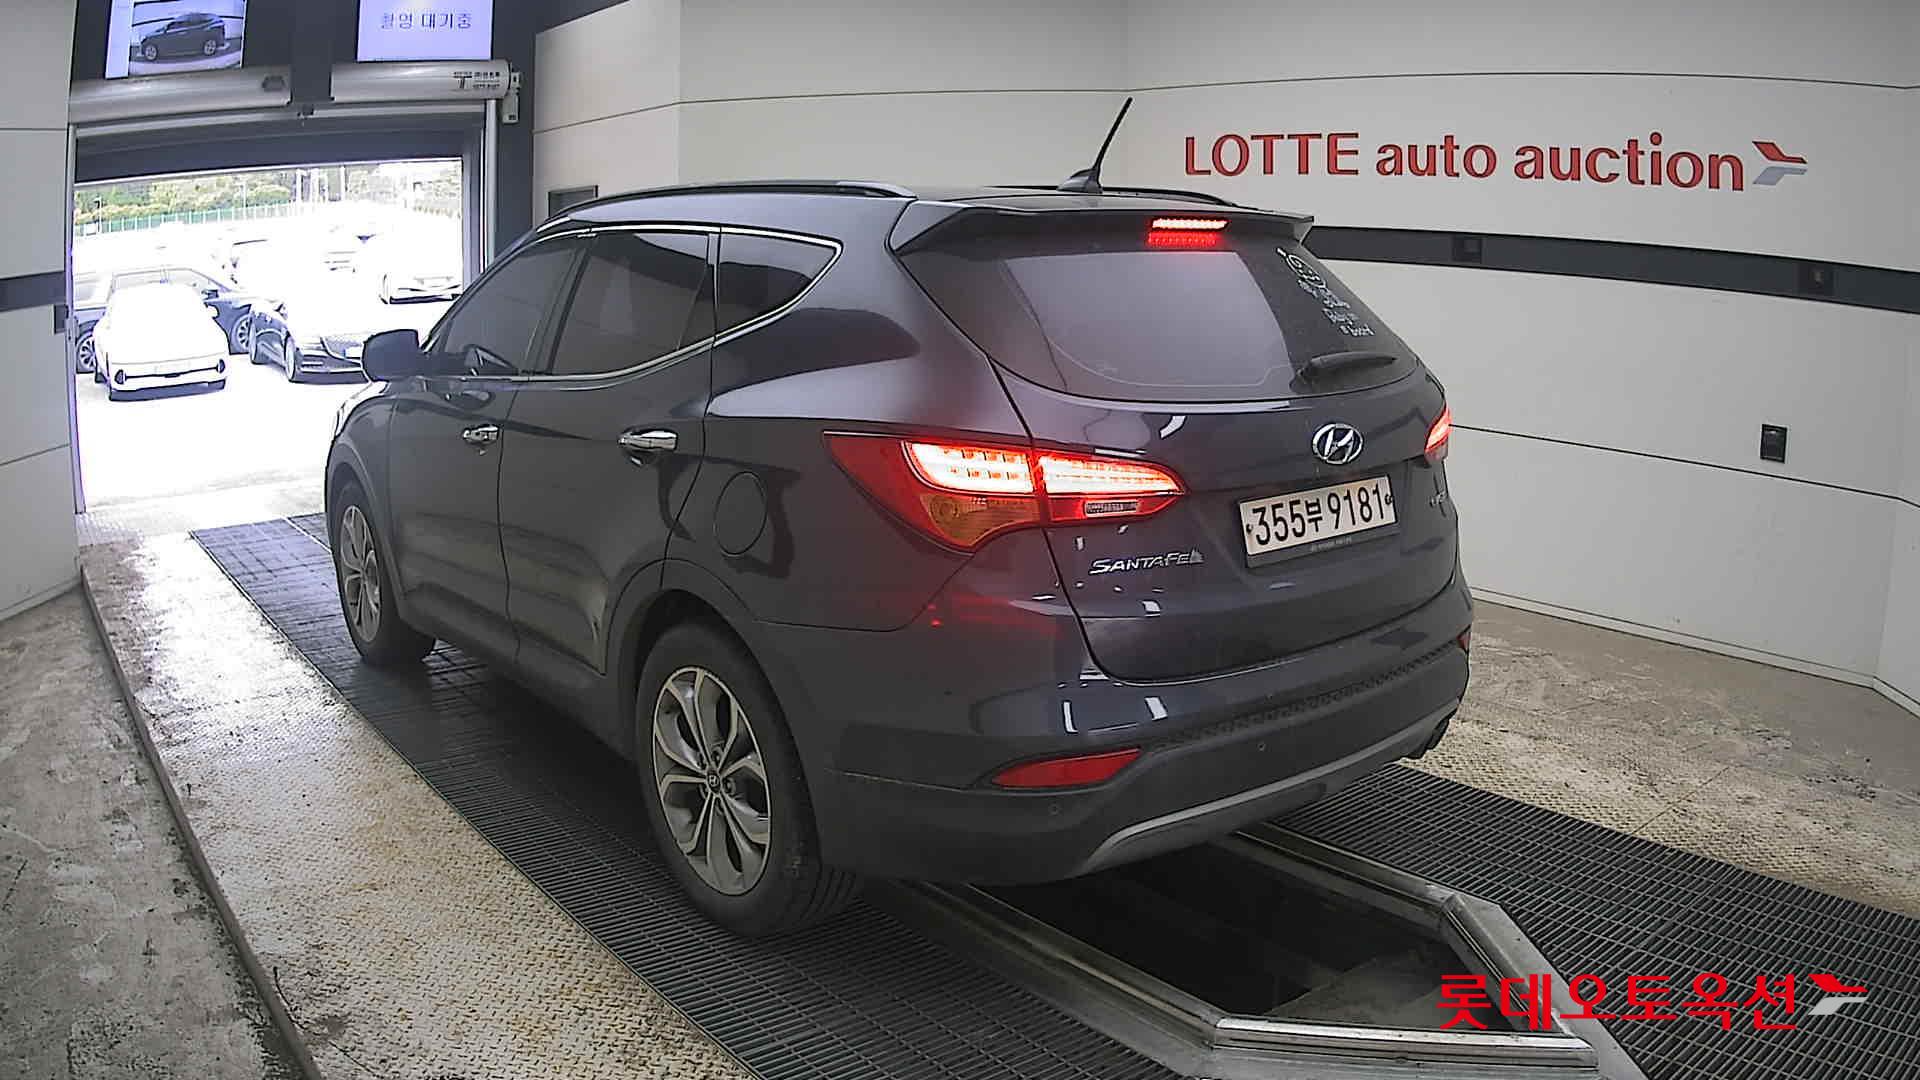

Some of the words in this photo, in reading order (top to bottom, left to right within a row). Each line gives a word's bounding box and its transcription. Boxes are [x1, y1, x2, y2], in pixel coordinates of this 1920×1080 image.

[1185, 132, 1359, 177] LOTTE
[1375, 135, 1498, 178] auto
[1514, 131, 1745, 192] auction
